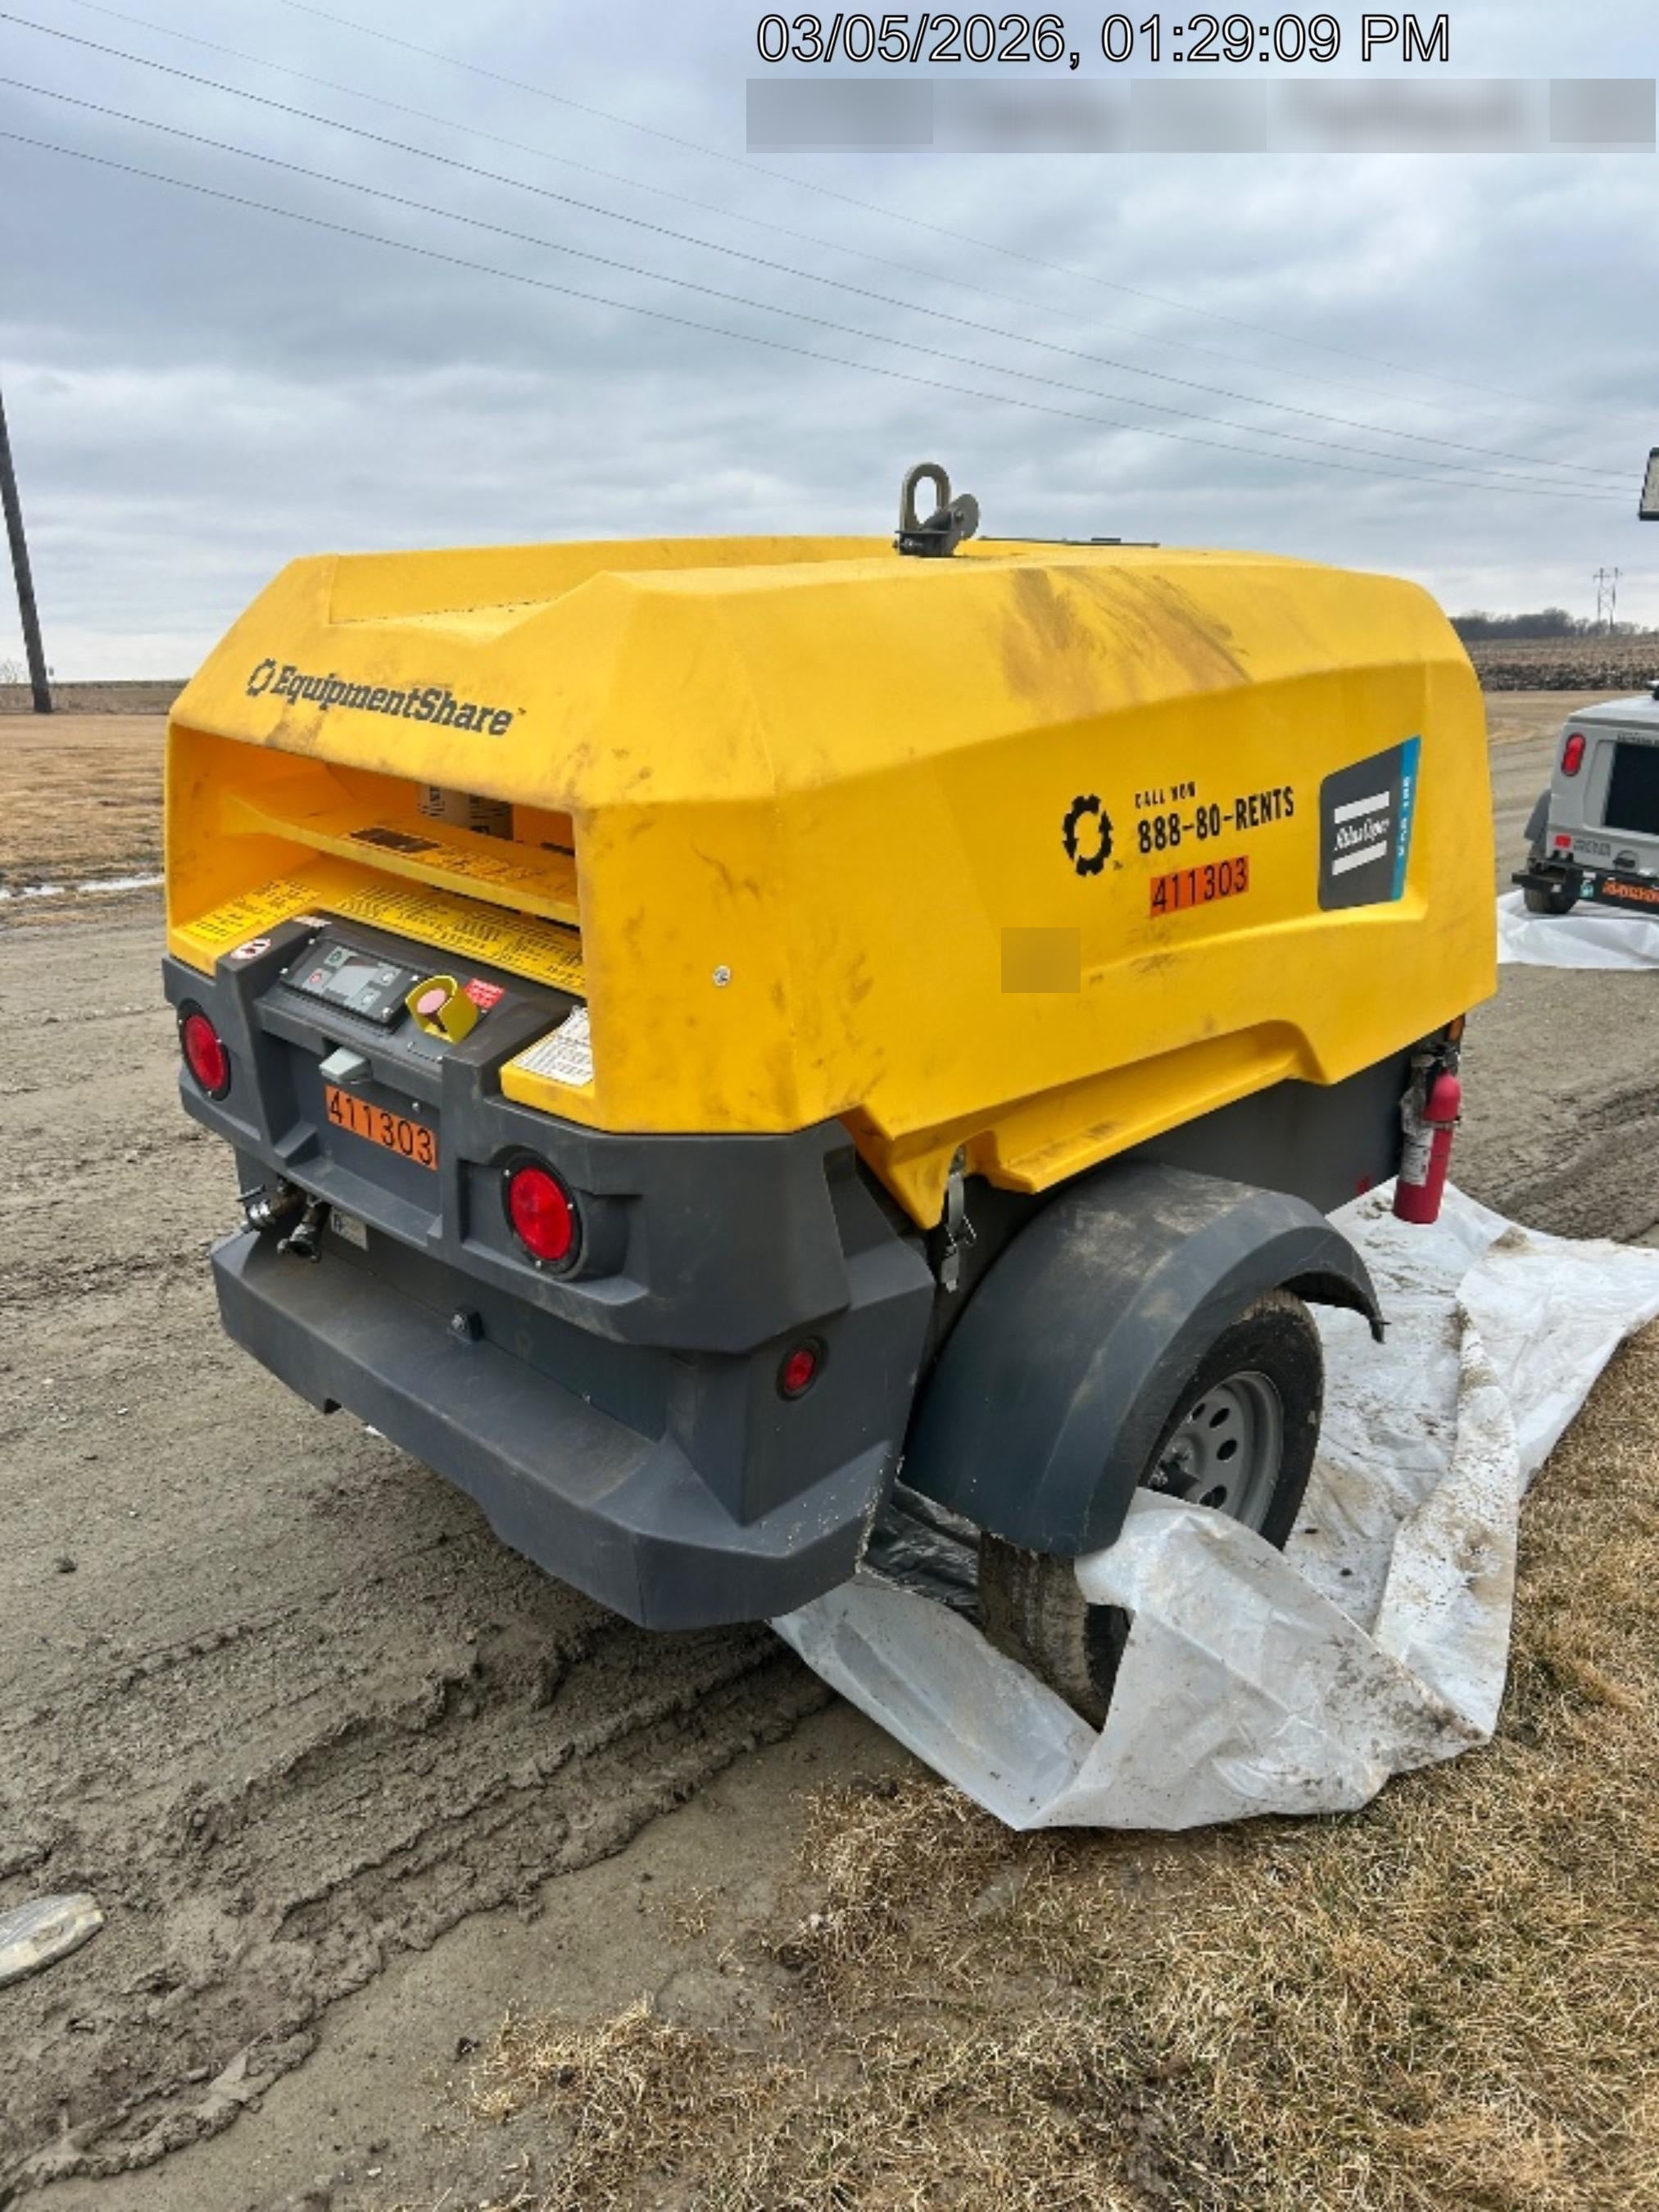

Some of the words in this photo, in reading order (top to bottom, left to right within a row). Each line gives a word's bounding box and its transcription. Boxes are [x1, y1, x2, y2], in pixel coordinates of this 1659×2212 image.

[270, 664, 514, 736] EquipmentShare
[1134, 787, 1165, 809] CALL
[1138, 785, 1294, 854] 888-80-RENTS
[1151, 856, 1247, 913] 411303
[330, 1090, 433, 1166] 411303
